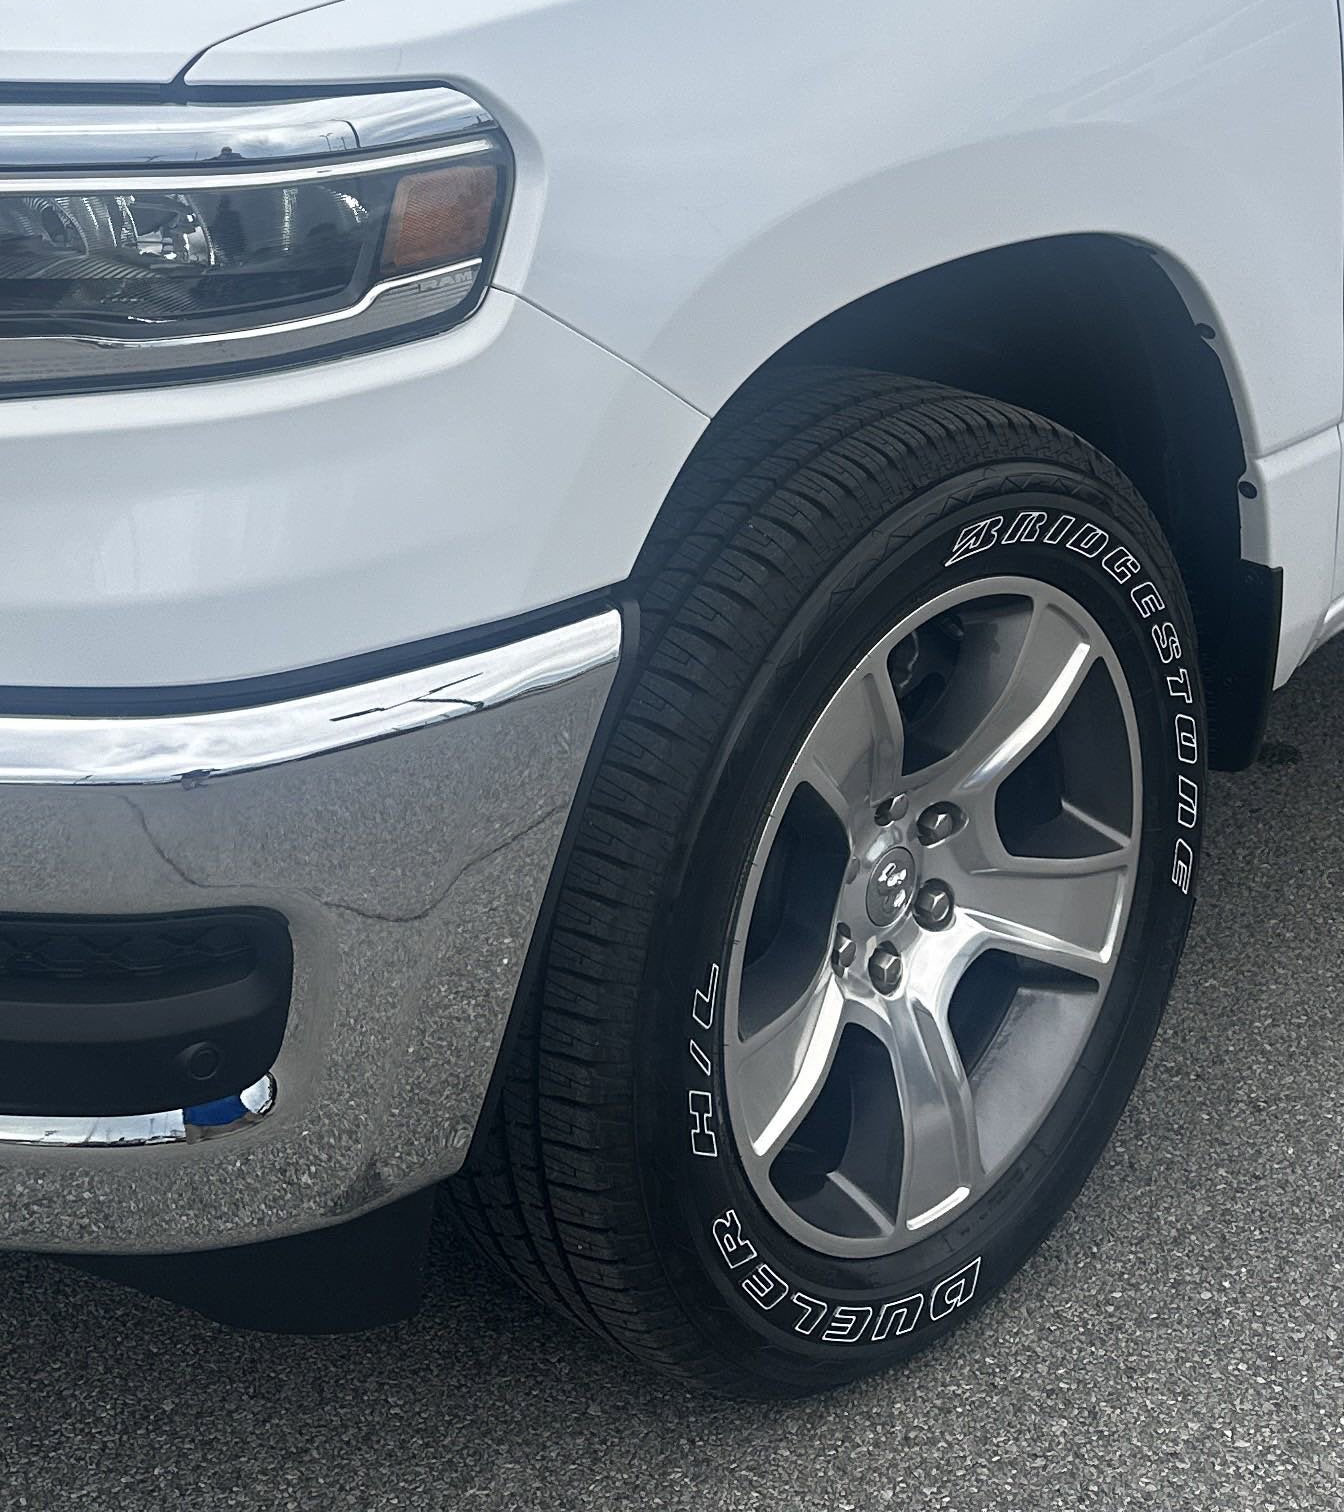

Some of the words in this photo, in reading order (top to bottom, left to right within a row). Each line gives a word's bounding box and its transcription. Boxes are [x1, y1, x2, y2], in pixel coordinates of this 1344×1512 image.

[944, 510, 1199, 896] BRIDGESTONE
[687, 962, 720, 1158] H/L
[712, 1209, 982, 1343] DUELER
